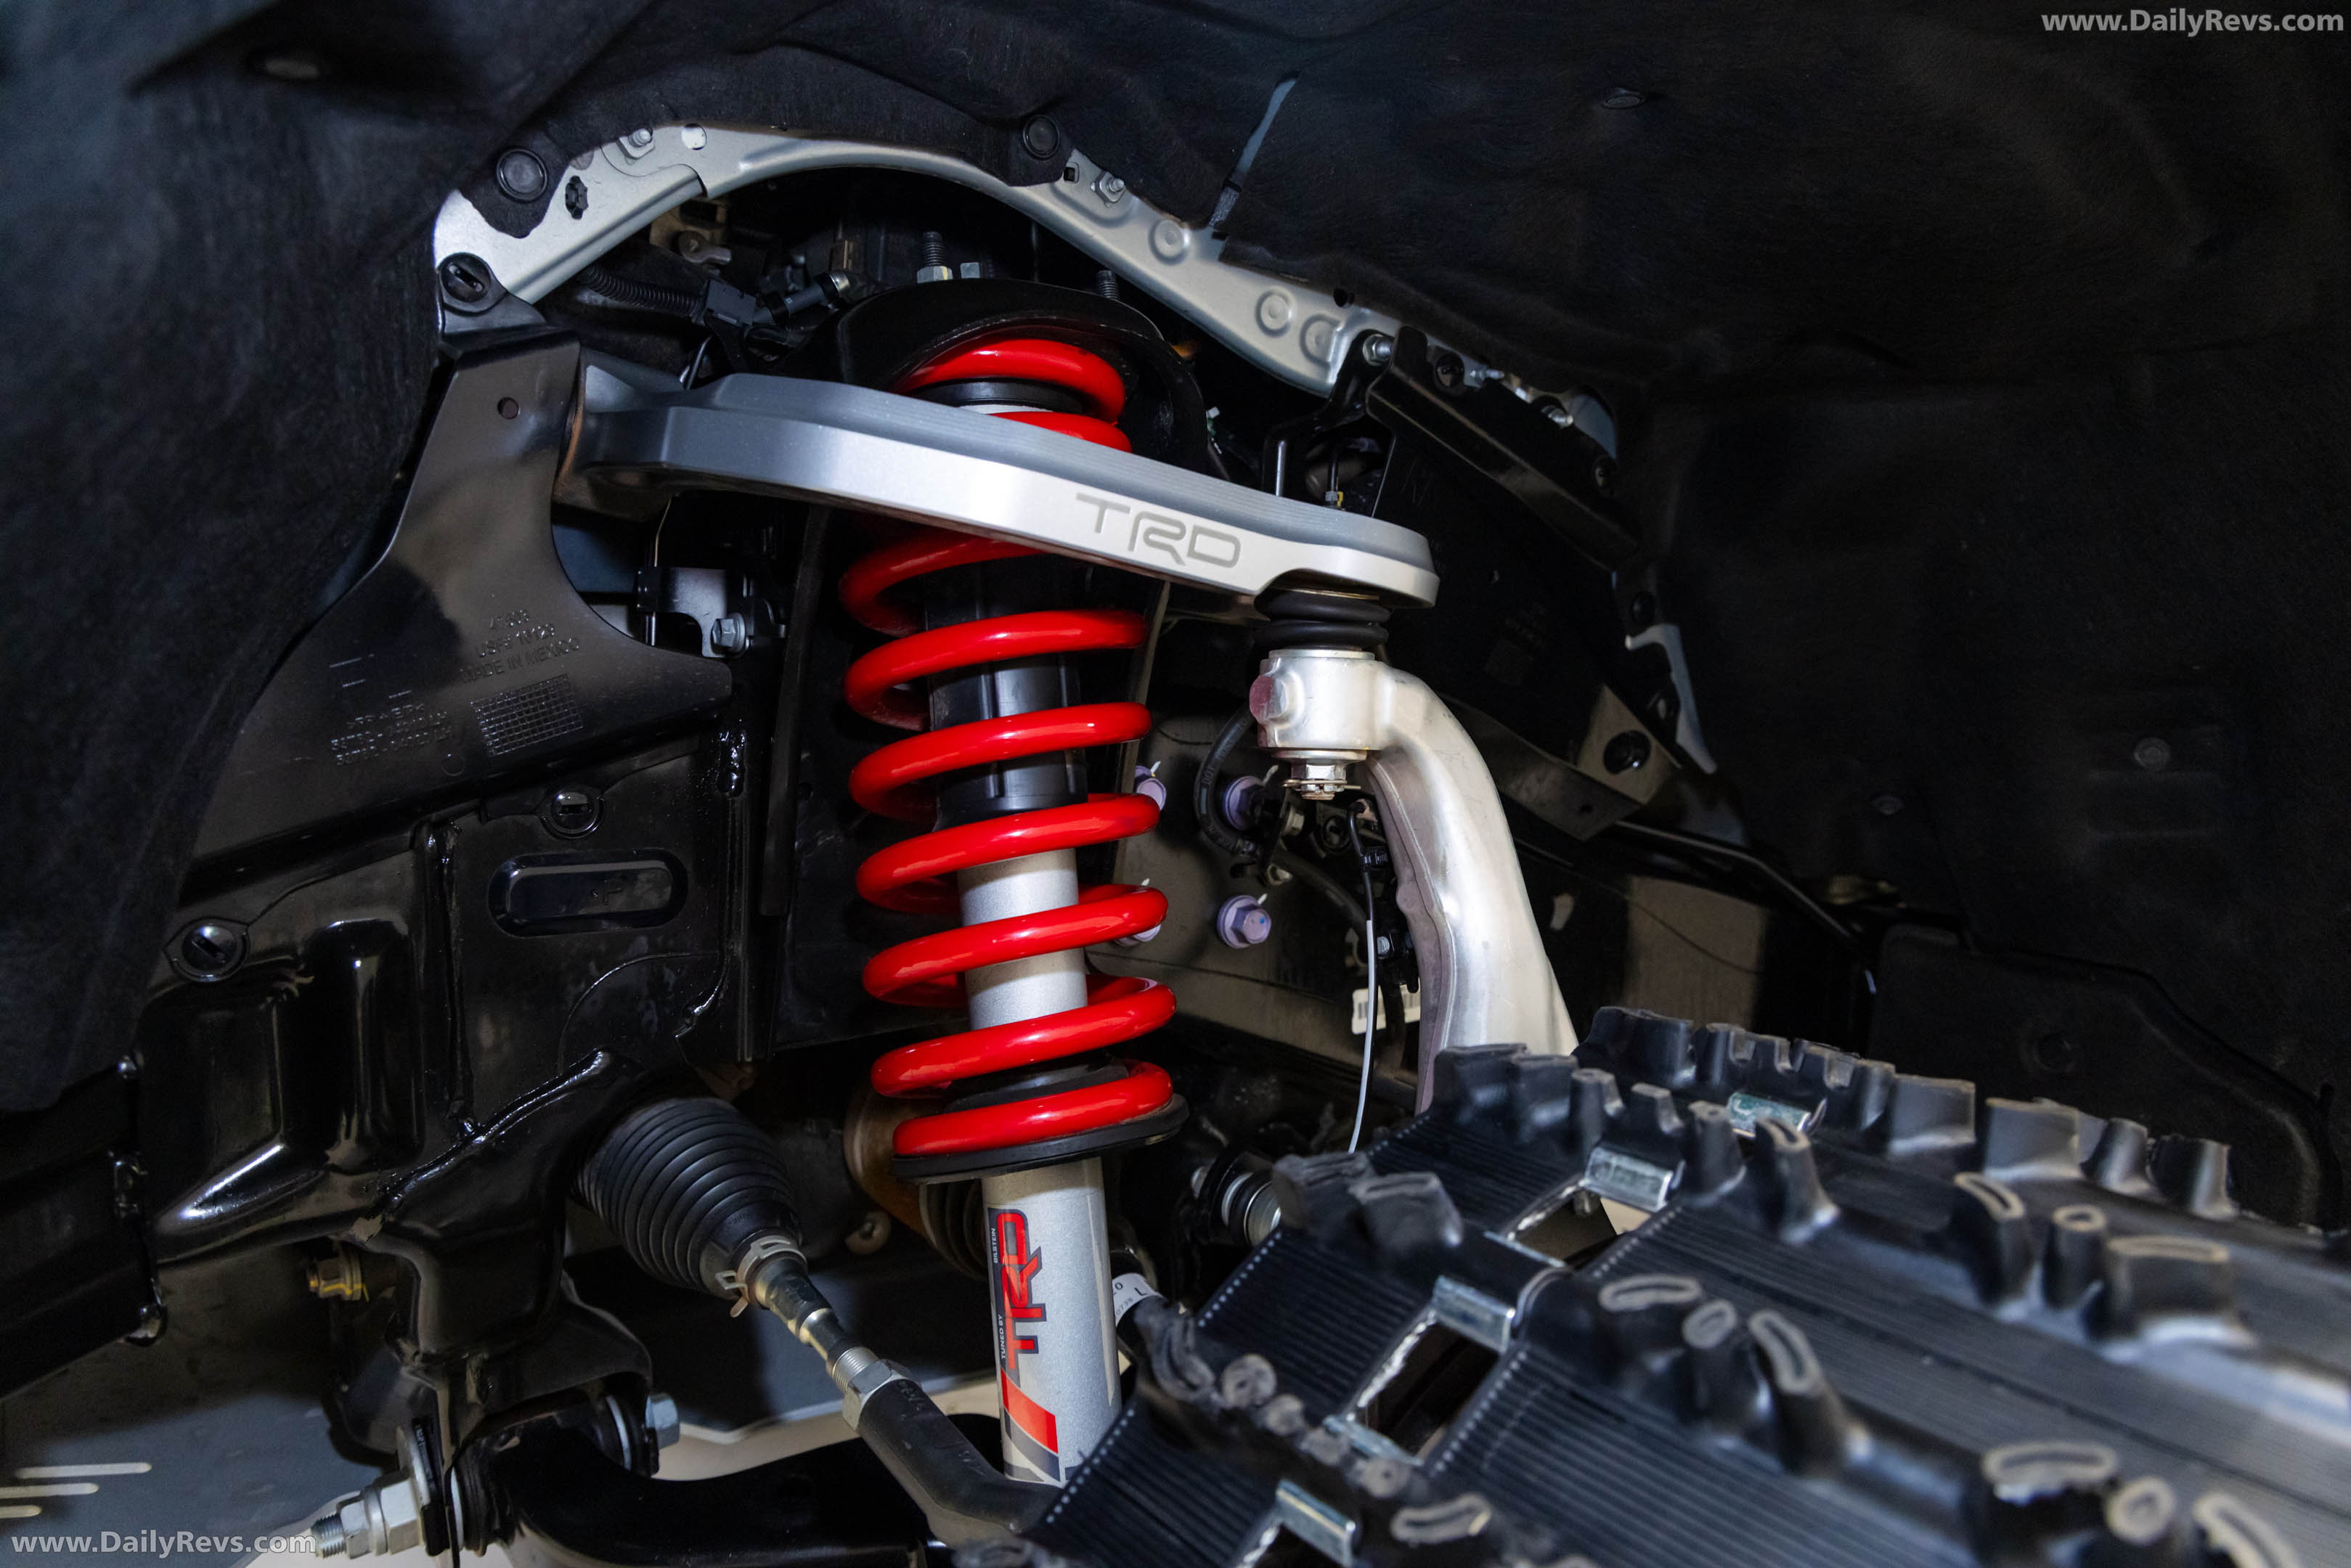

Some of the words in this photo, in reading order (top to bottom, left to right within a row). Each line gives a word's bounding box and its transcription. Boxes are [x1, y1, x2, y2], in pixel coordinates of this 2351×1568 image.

[1075, 492, 1242, 568] TRD
[997, 1212, 1044, 1371] TRD
[997, 1313, 1004, 1326] BY
